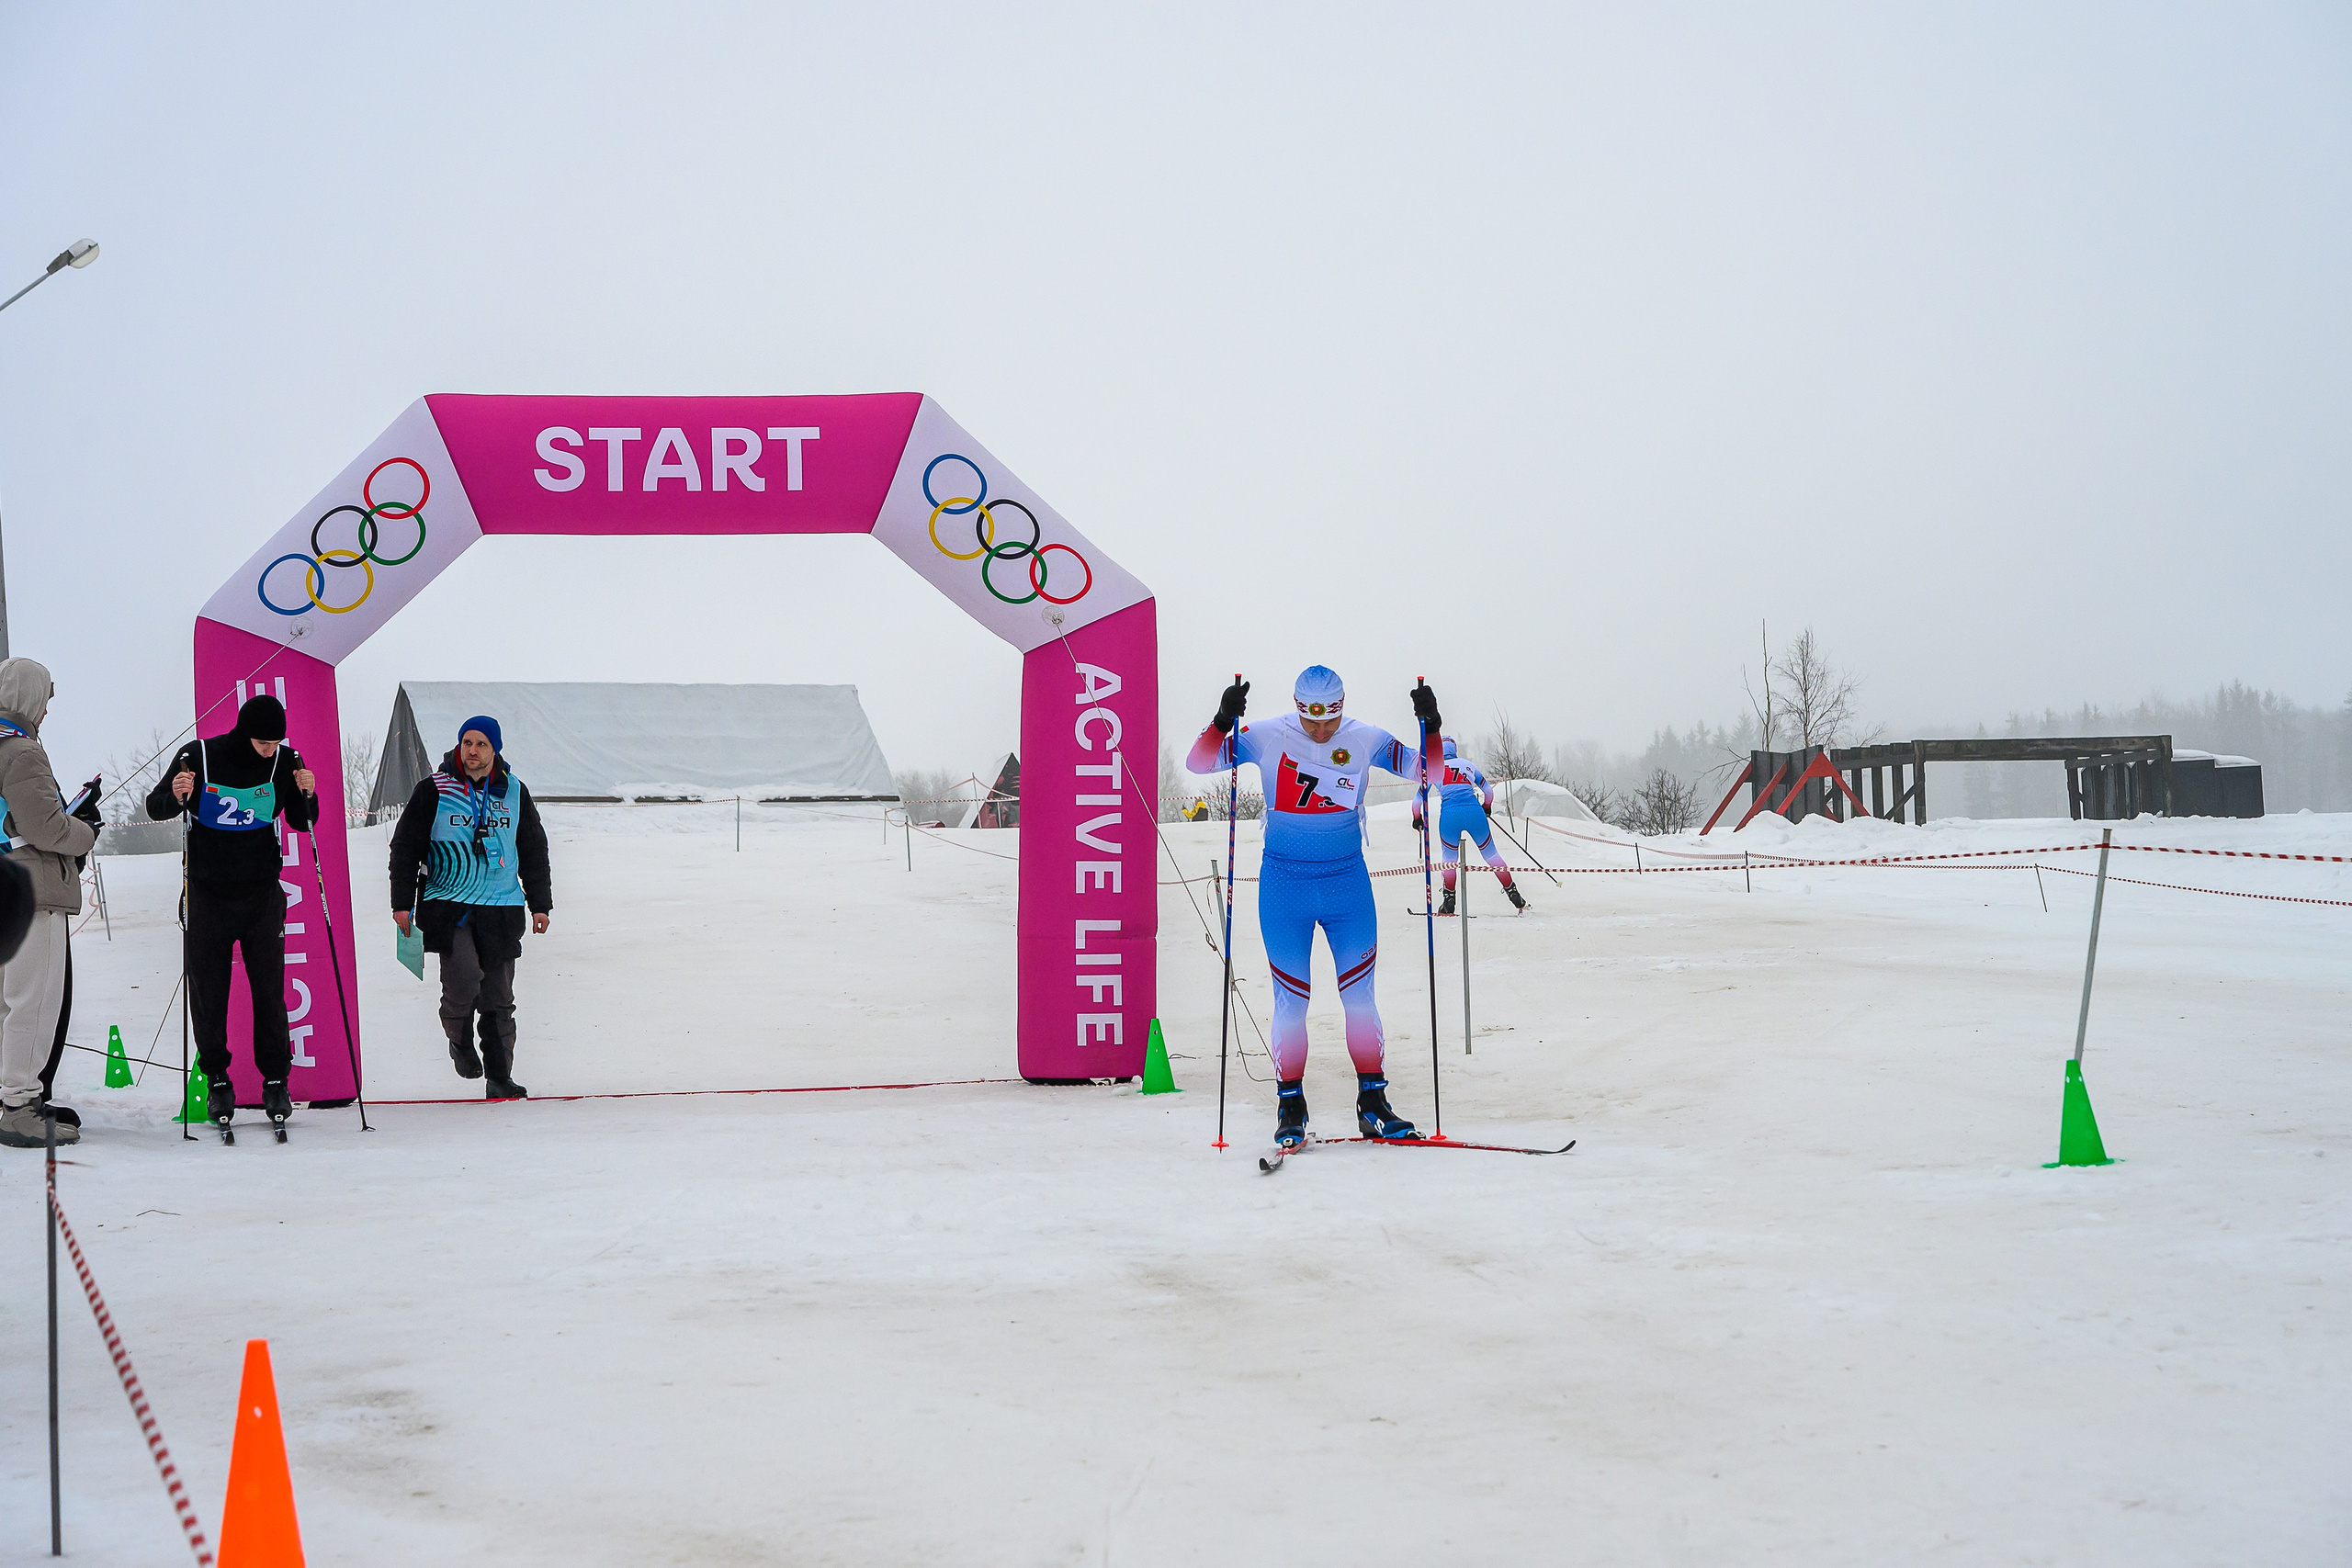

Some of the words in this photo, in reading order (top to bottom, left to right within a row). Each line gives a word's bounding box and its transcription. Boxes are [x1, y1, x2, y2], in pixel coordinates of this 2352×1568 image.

[533, 426, 820, 492] START
[217, 796, 255, 825] 2.3
[1075, 662, 1122, 894] ACTIVE
[449, 814, 511, 829] СУЬЯ
[1075, 919, 1123, 1046] LIFE
